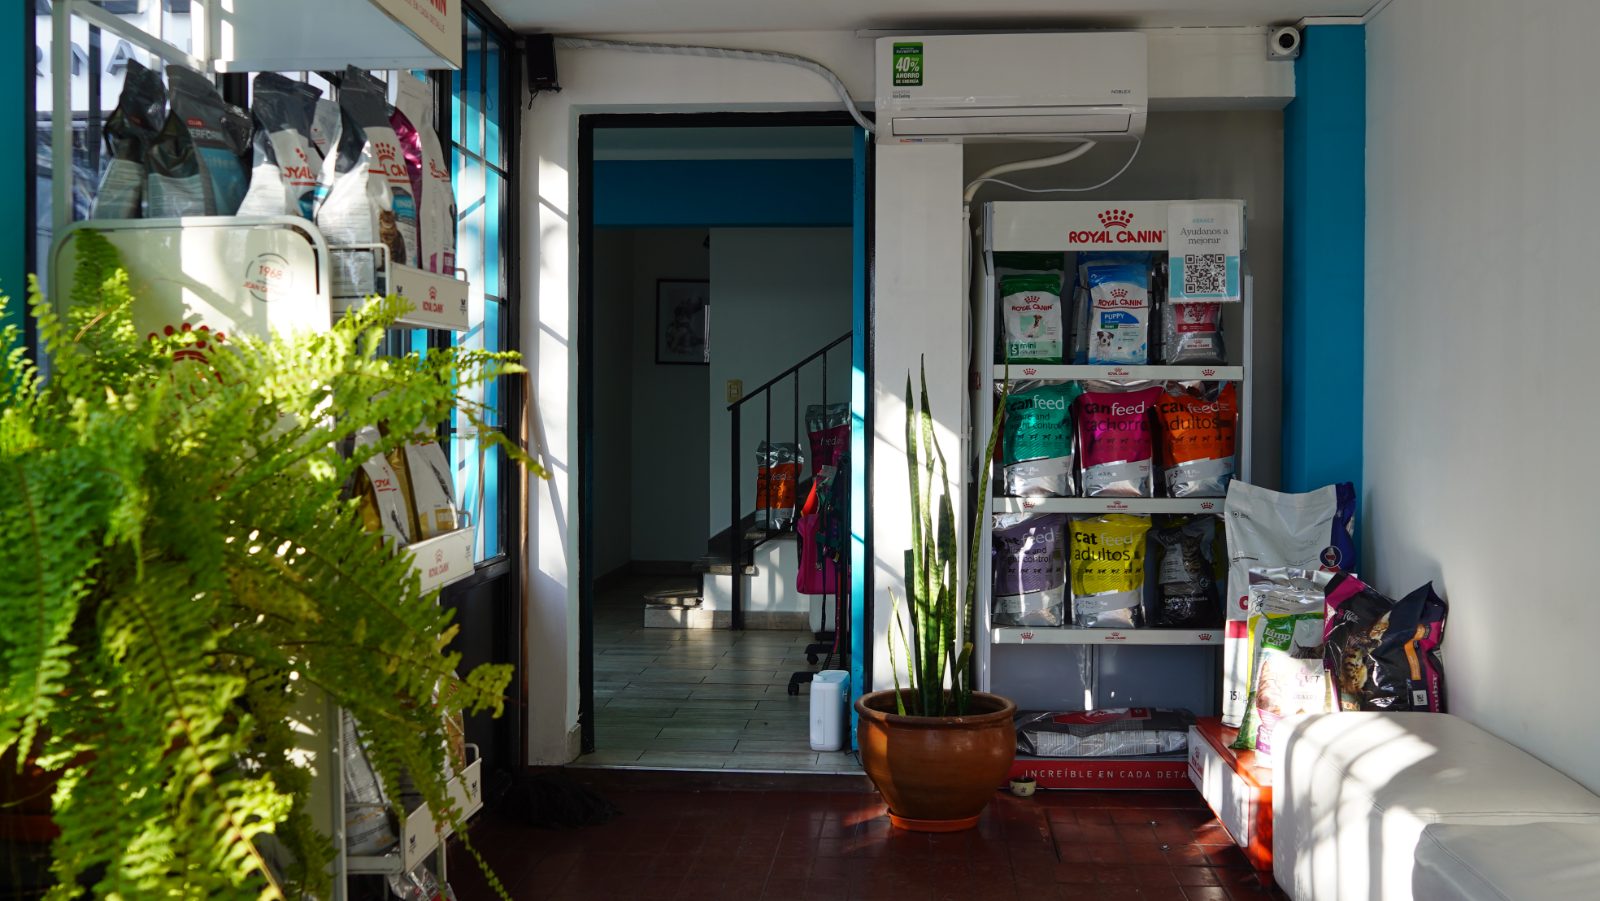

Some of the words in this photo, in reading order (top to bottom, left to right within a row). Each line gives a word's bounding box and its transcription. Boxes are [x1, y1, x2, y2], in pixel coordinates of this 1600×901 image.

[895, 56, 920, 72] 40%
[1068, 230, 1113, 244] ROYAL
[1116, 230, 1163, 244] CANIN
[1180, 227, 1222, 238] Ayudanos
[1187, 237, 1221, 245] mejorar
[1011, 304, 1032, 312] ROYAL
[1032, 303, 1053, 311] CANIN
[1119, 298, 1142, 306] CANIN
[1104, 312, 1125, 320] PUPPY
[1074, 531, 1098, 545] cat
[1100, 528, 1133, 546] feed
[1074, 546, 1131, 561] adultos
[1229, 690, 1238, 701] 15
[1025, 767, 1093, 778] INCREÍBLE
[1098, 770, 1113, 778] EN
[1119, 769, 1151, 778] CADA
